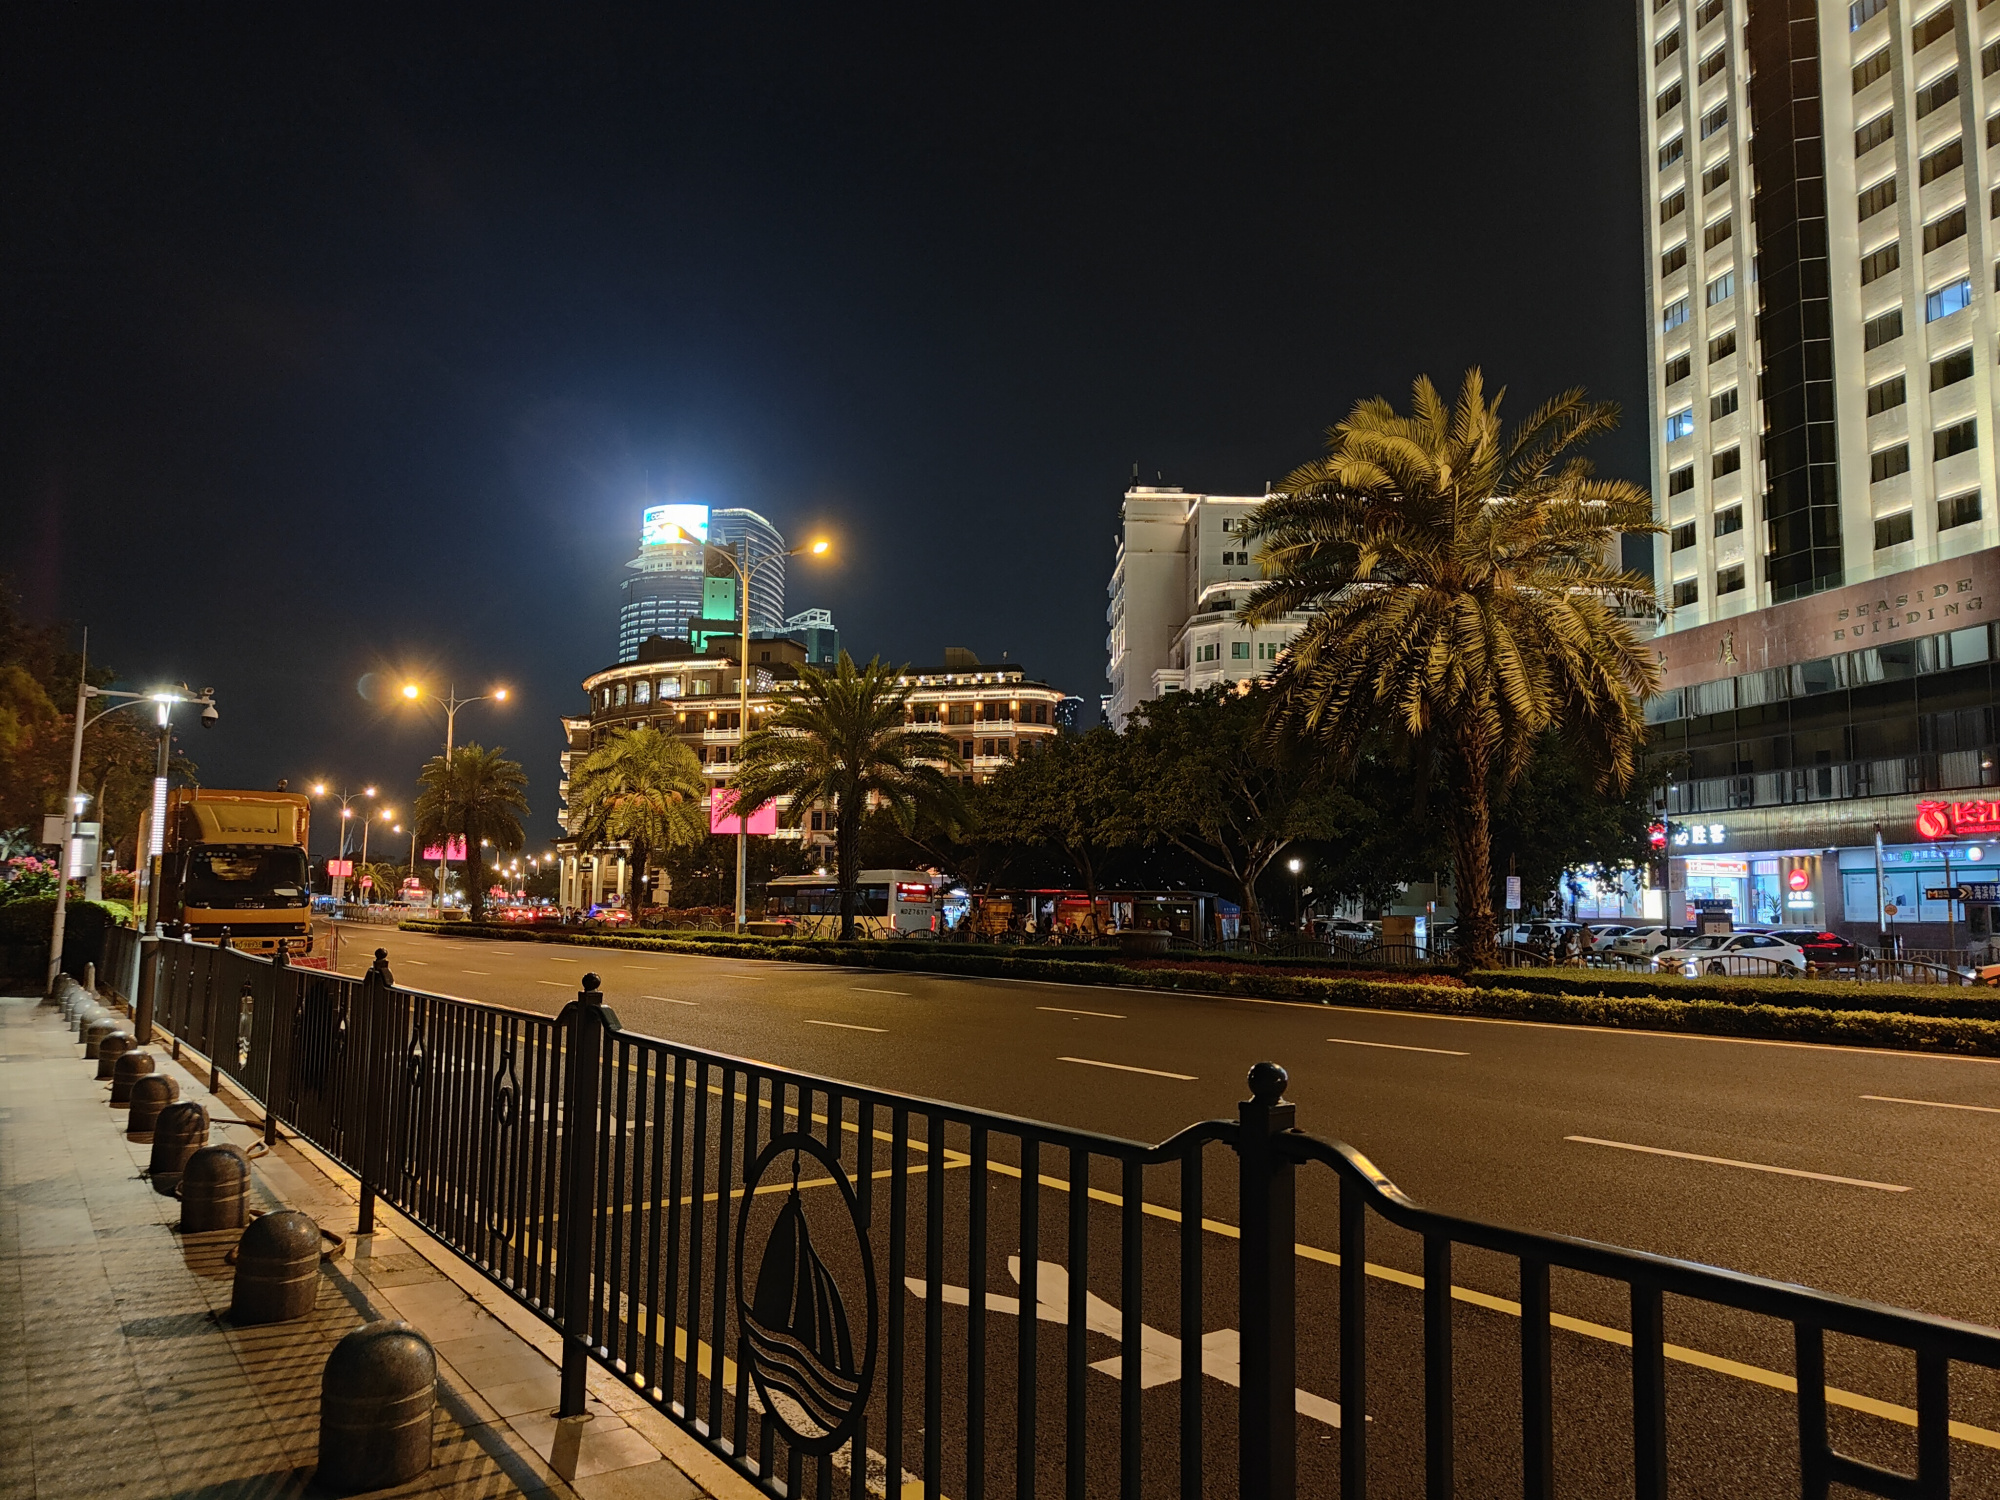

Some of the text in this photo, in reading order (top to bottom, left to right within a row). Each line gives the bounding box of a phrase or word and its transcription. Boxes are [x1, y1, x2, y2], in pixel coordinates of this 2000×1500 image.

[1838, 578, 1973, 621] SEASIDE
[1833, 597, 1983, 641] BUILDING
[221, 826, 277, 834] ISUZU
[1674, 824, 1725, 846] 必胜客
